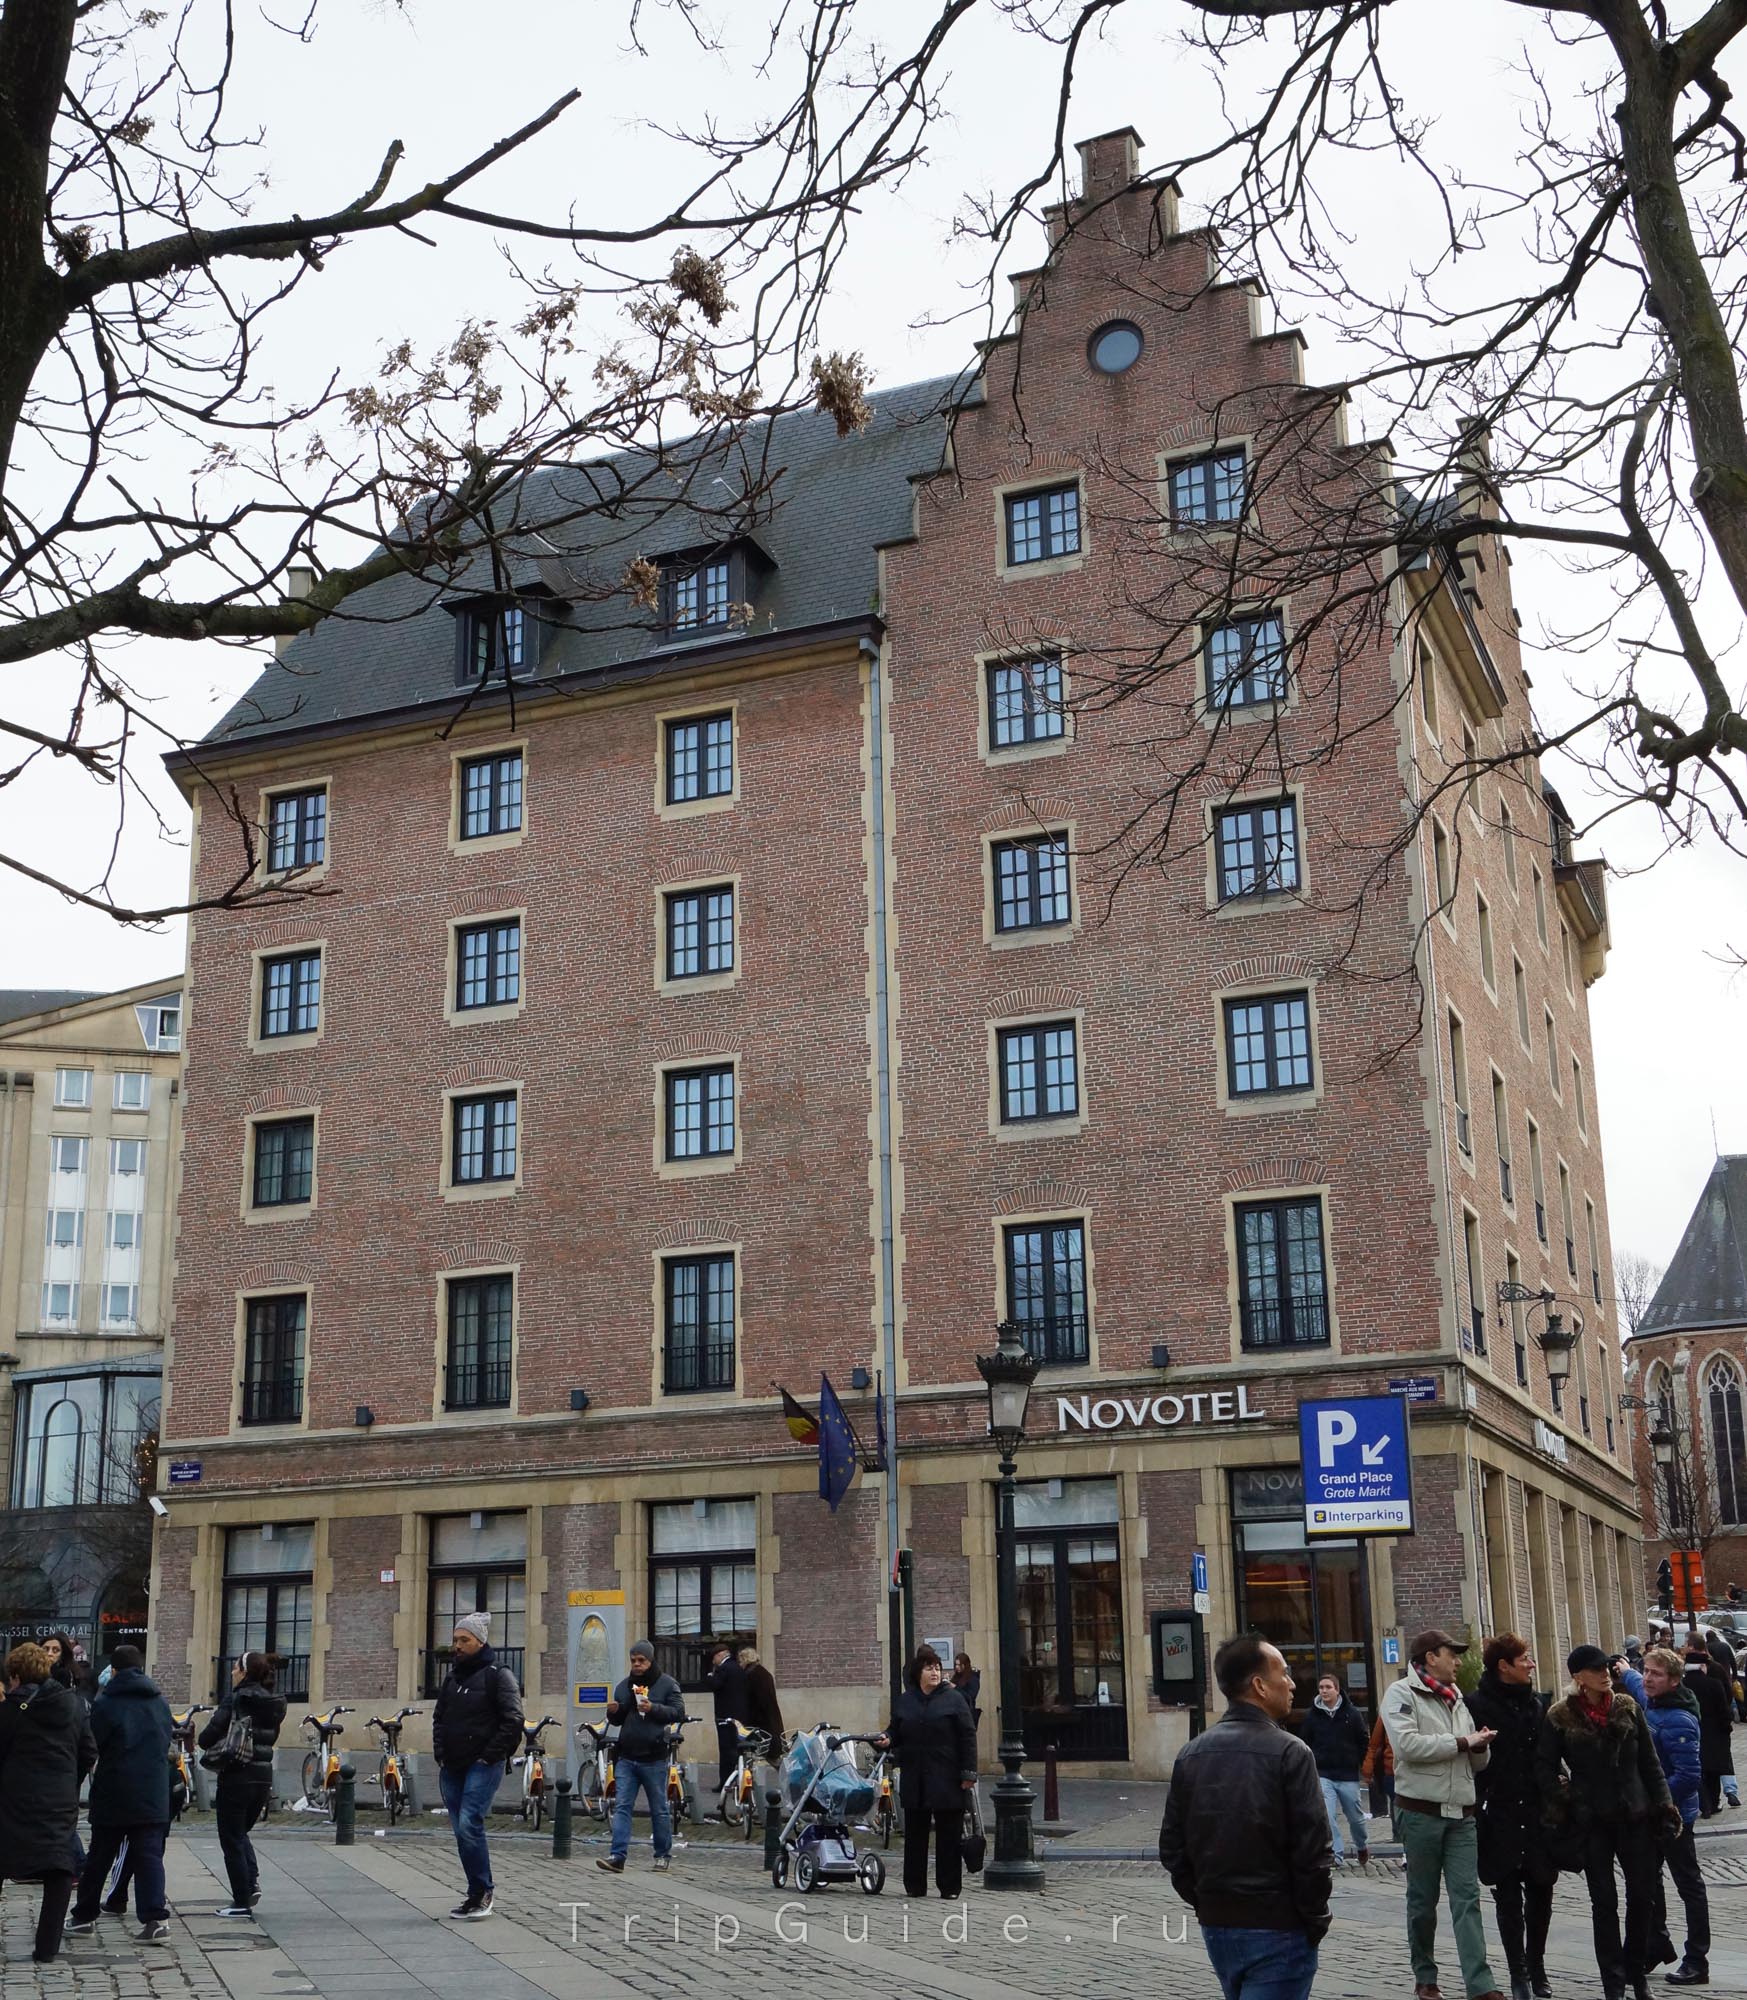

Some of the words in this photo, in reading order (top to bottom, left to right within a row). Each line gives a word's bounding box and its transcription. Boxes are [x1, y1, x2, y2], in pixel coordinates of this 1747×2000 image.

[1056, 1385, 1265, 1431] NOVOTEL
[1317, 1410, 1357, 1467] P
[1319, 1472, 1356, 1485] Grand
[1359, 1471, 1393, 1483] Place
[1324, 1487, 1355, 1499] Grote
[1358, 1485, 1391, 1498] Markt
[1328, 1509, 1404, 1523] Interparking
[1382, 1627, 1398, 1637] 120
